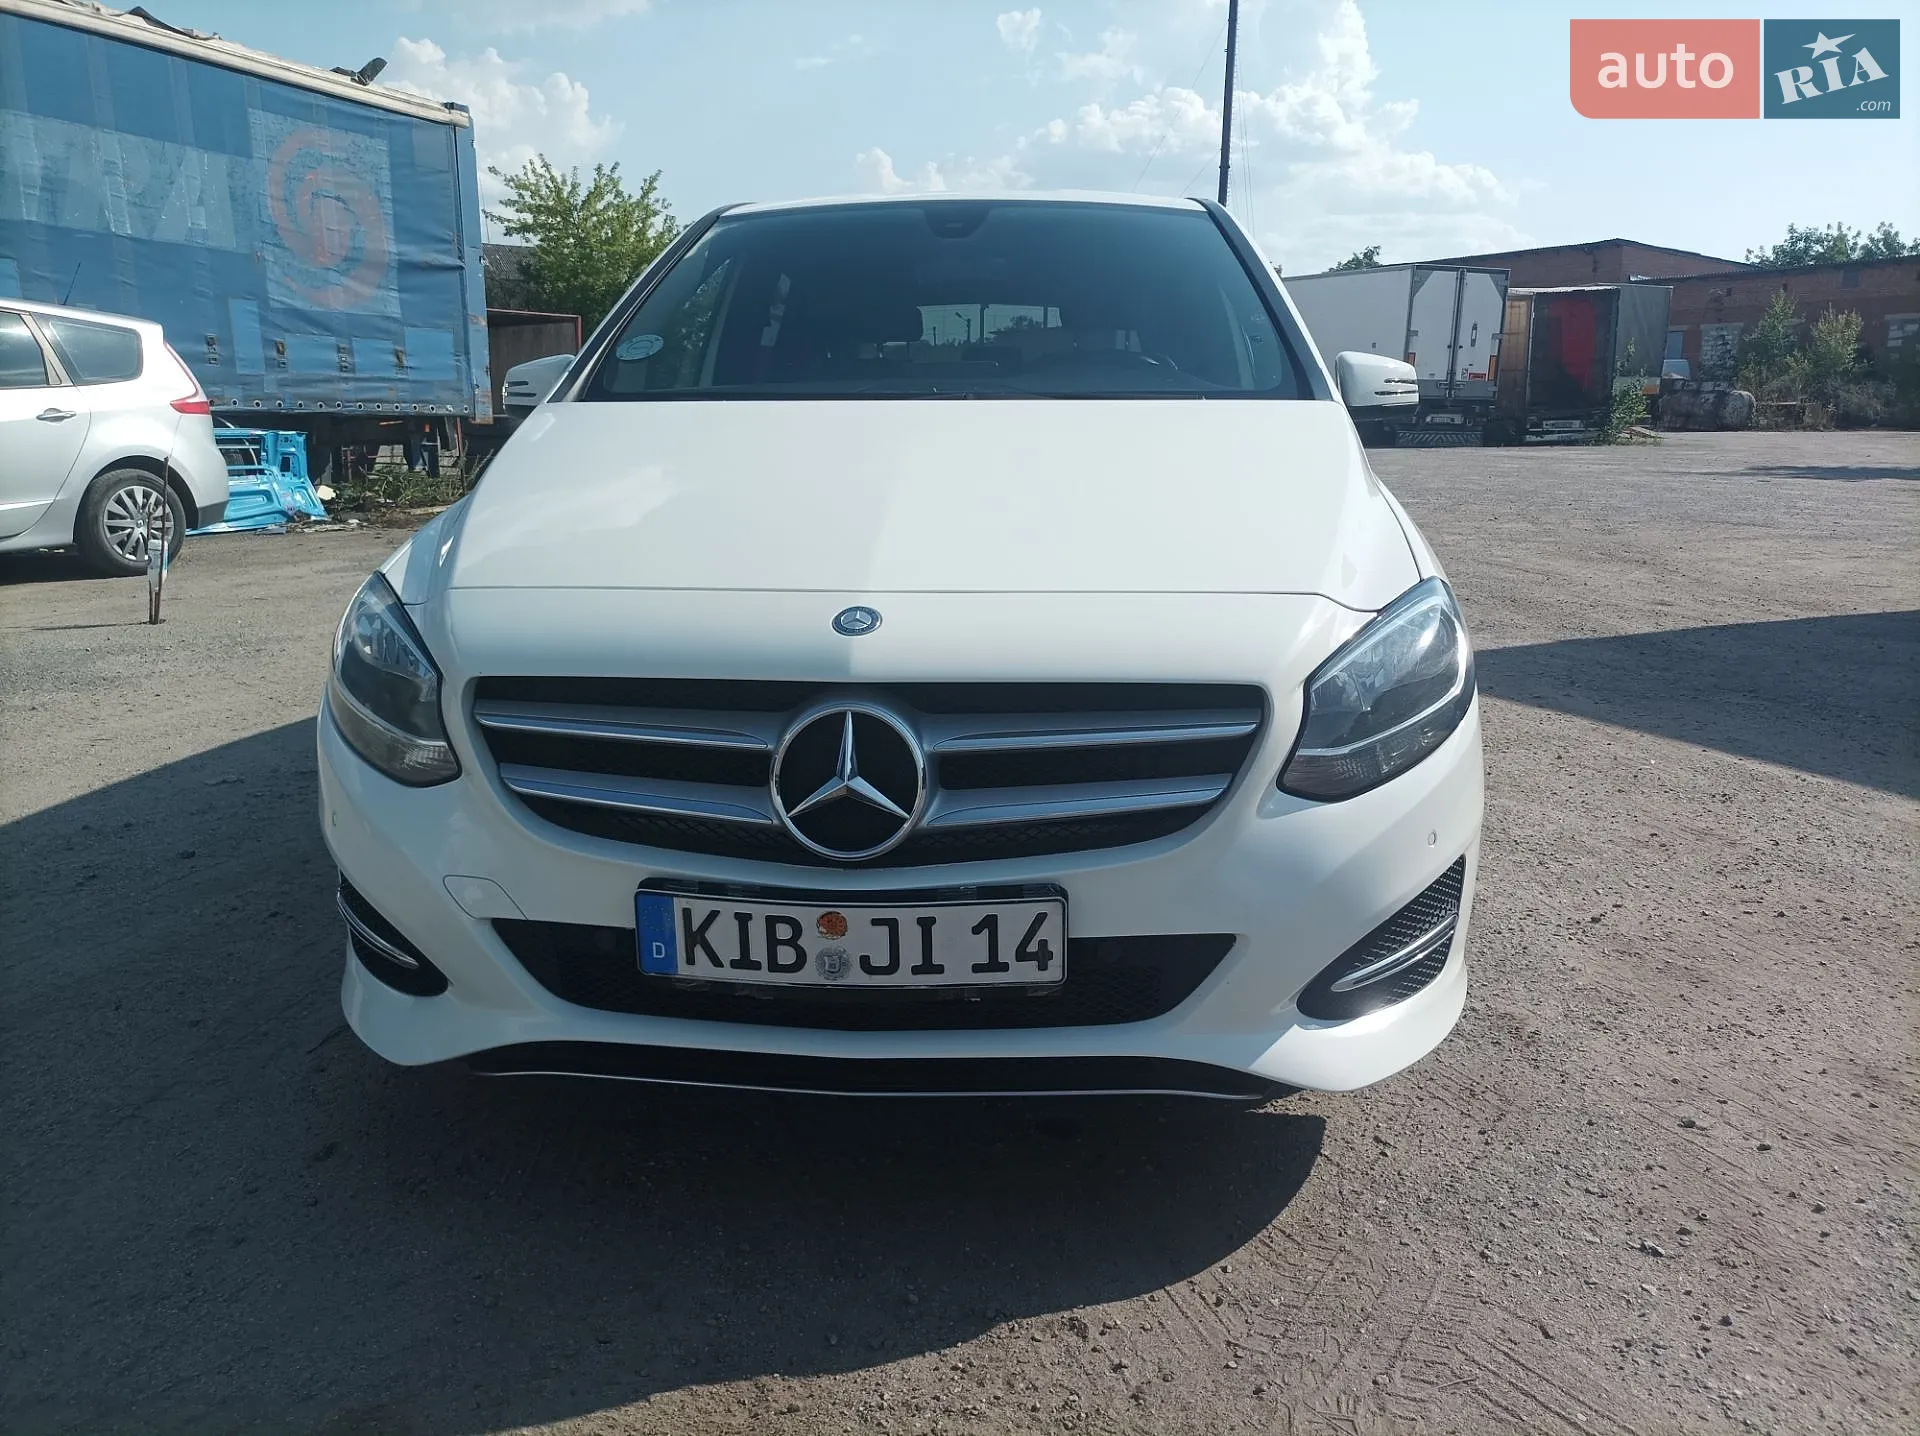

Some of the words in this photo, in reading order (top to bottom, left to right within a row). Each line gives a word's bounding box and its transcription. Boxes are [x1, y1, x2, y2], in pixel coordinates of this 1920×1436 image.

[652, 942, 665, 958] D
[682, 907, 807, 974] KIB
[859, 916, 945, 976] JI
[970, 911, 1054, 974] 14
